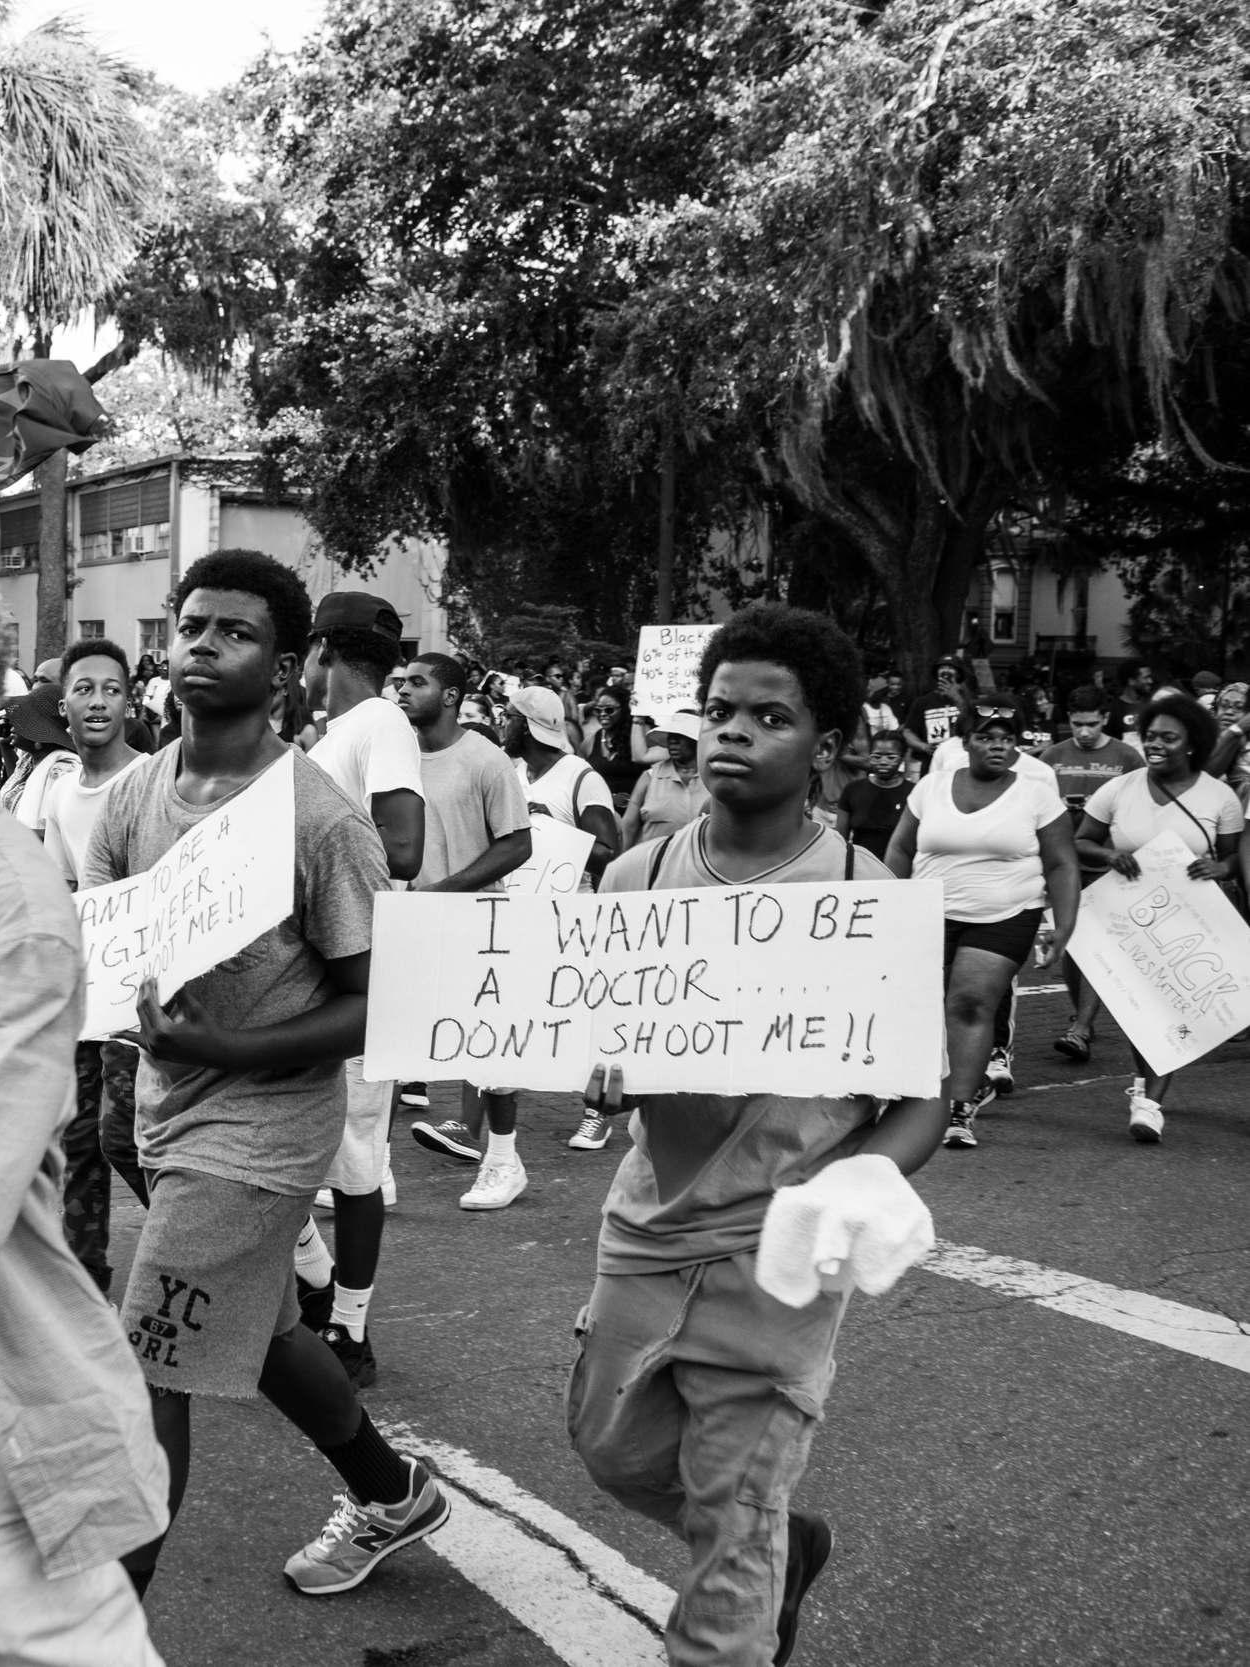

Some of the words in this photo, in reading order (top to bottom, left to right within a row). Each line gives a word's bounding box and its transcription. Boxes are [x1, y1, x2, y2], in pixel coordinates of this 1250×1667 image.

[667, 647, 682, 662] of
[80, 886, 139, 927] ANT
[151, 865, 172, 902] TO
[178, 829, 205, 875] BE
[217, 814, 231, 840] A
[475, 897, 511, 955] I
[552, 898, 700, 957] WANT
[724, 890, 784, 943] TO
[809, 893, 879, 941] BE
[1127, 885, 1240, 1015] BLACK
[474, 966, 501, 1007] A
[428, 1017, 572, 1062] DON'T
[599, 1020, 744, 1057] SHOOT
[157, 1274, 211, 1332] YC
